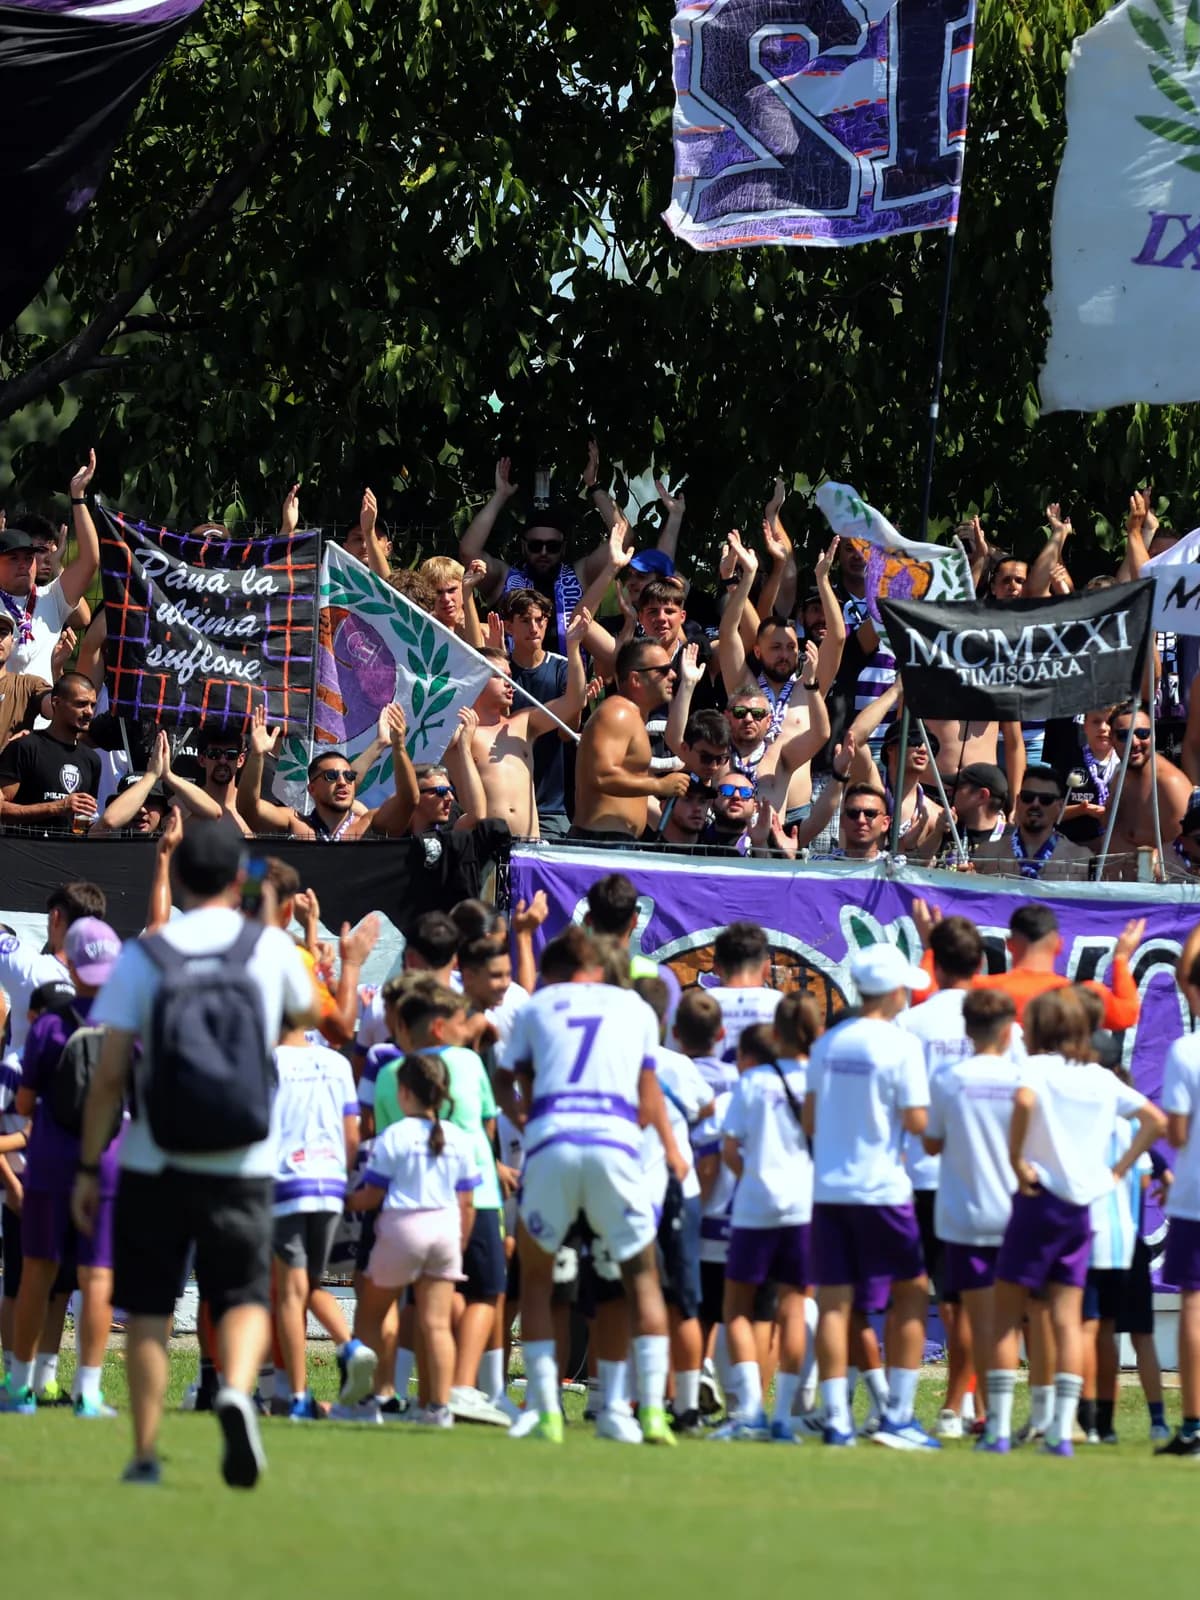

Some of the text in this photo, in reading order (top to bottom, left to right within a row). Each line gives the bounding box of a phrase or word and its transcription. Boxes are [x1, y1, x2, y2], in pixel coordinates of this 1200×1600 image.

[241, 565, 280, 595] la
[156, 599, 261, 636] ultima
[905, 610, 1132, 669] MCMXXI
[146, 640, 262, 685] suflare
[956, 658, 1085, 688] TIMIȘOARA
[566, 1015, 602, 1084] 7
